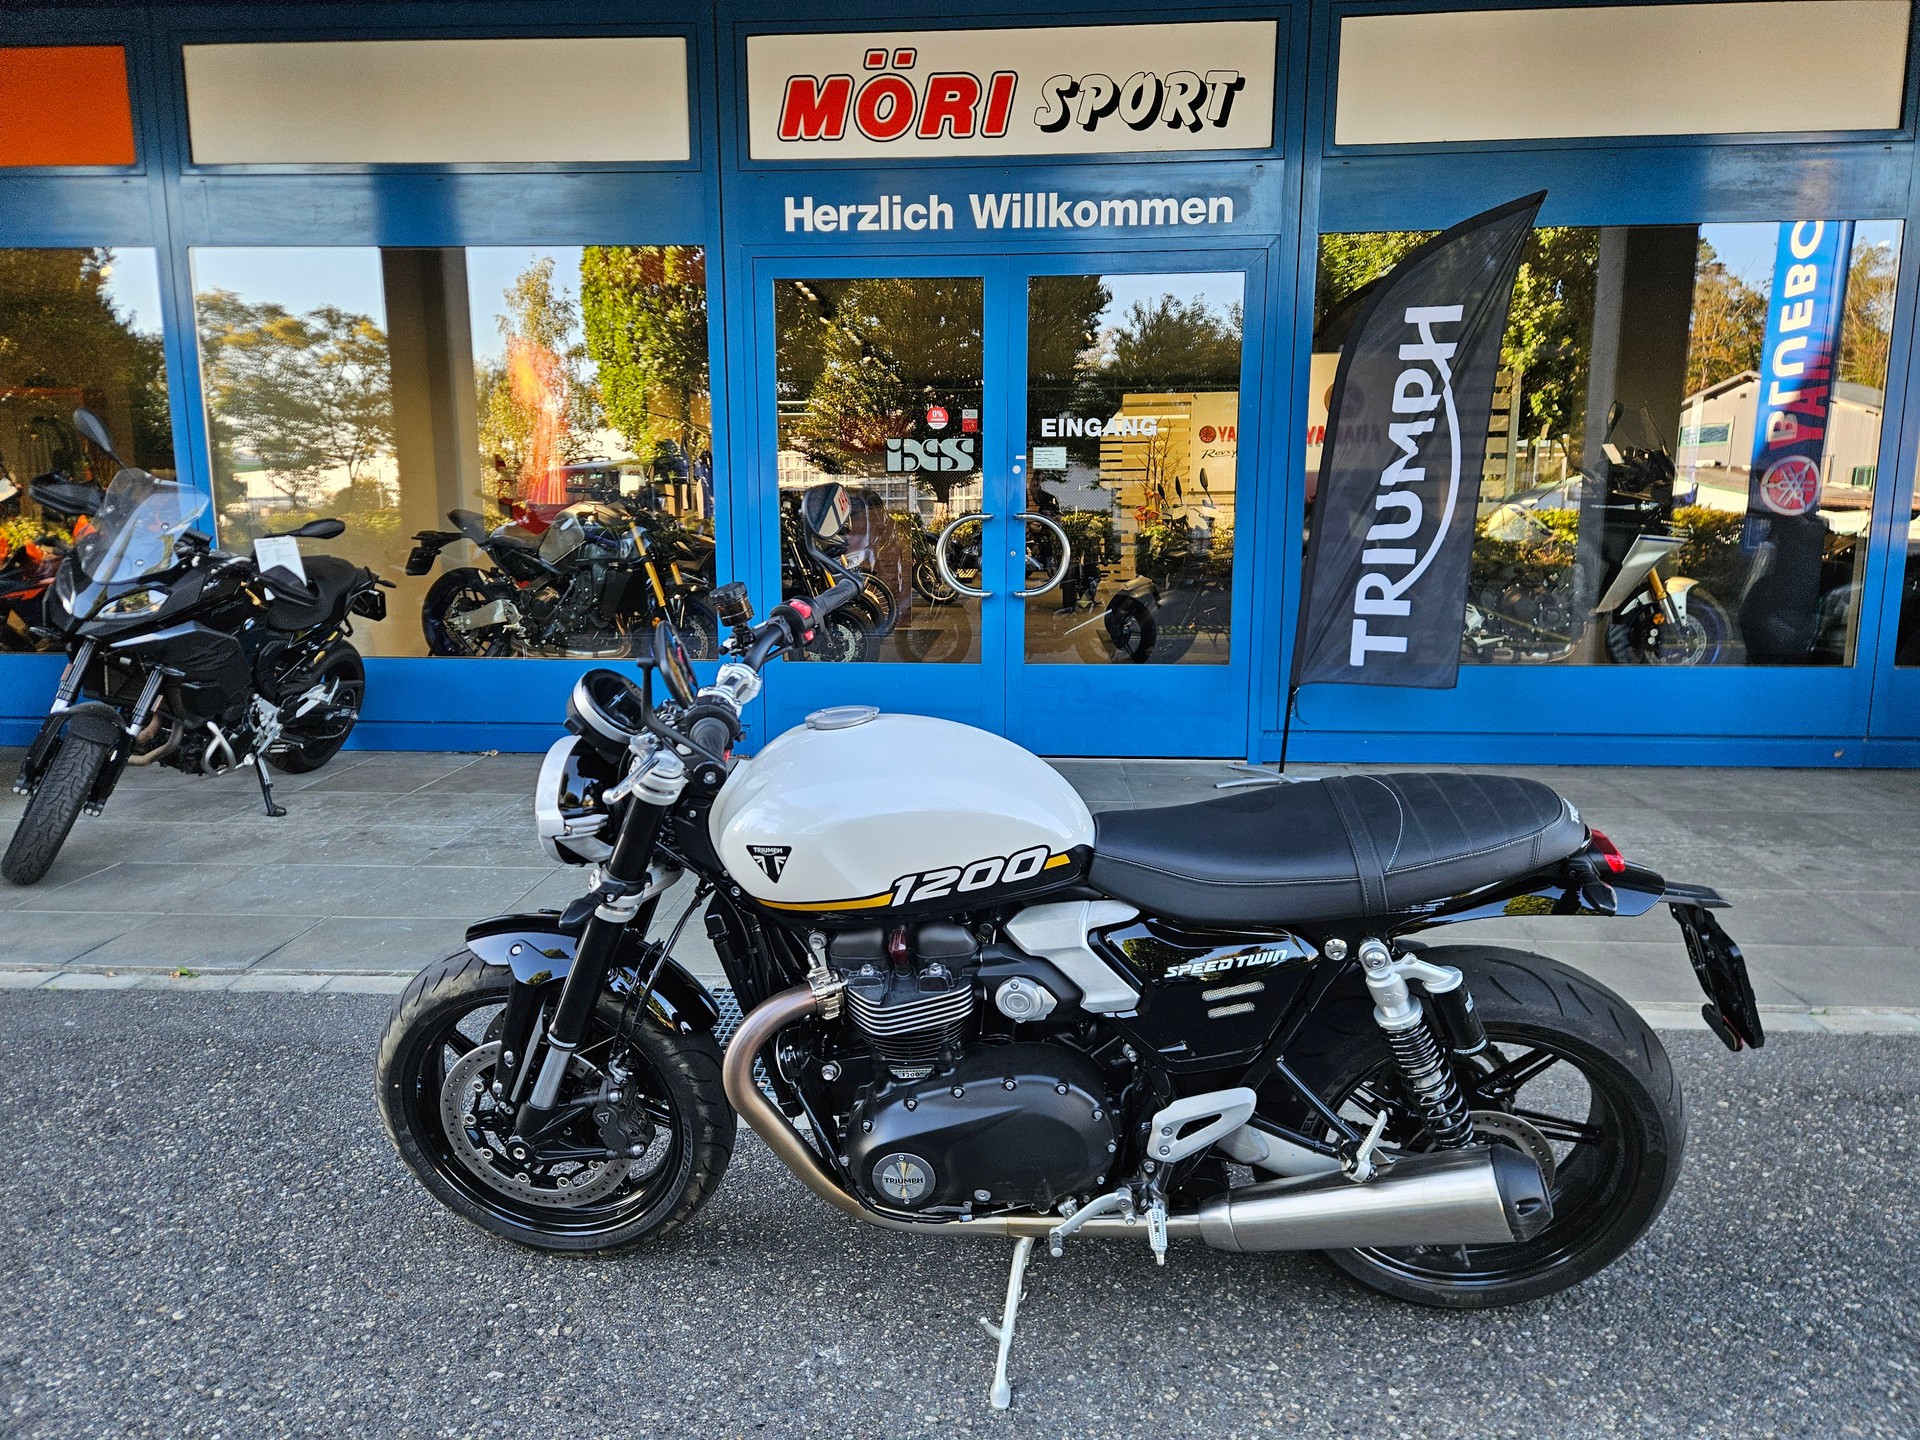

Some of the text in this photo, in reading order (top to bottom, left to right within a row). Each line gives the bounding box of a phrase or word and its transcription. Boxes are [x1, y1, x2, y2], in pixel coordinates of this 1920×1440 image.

[777, 47, 1245, 142] MÖRI SPORT
[784, 192, 1234, 231] Herzlich Willkommen
[1041, 417, 1157, 437] EINGANG
[1350, 304, 1464, 666] TRIUMPH
[753, 847, 783, 856] TRIUMPH
[891, 847, 1049, 907] 1200
[1164, 949, 1288, 978] SPEED TWIN
[884, 1176, 924, 1187] TRIUMPH
